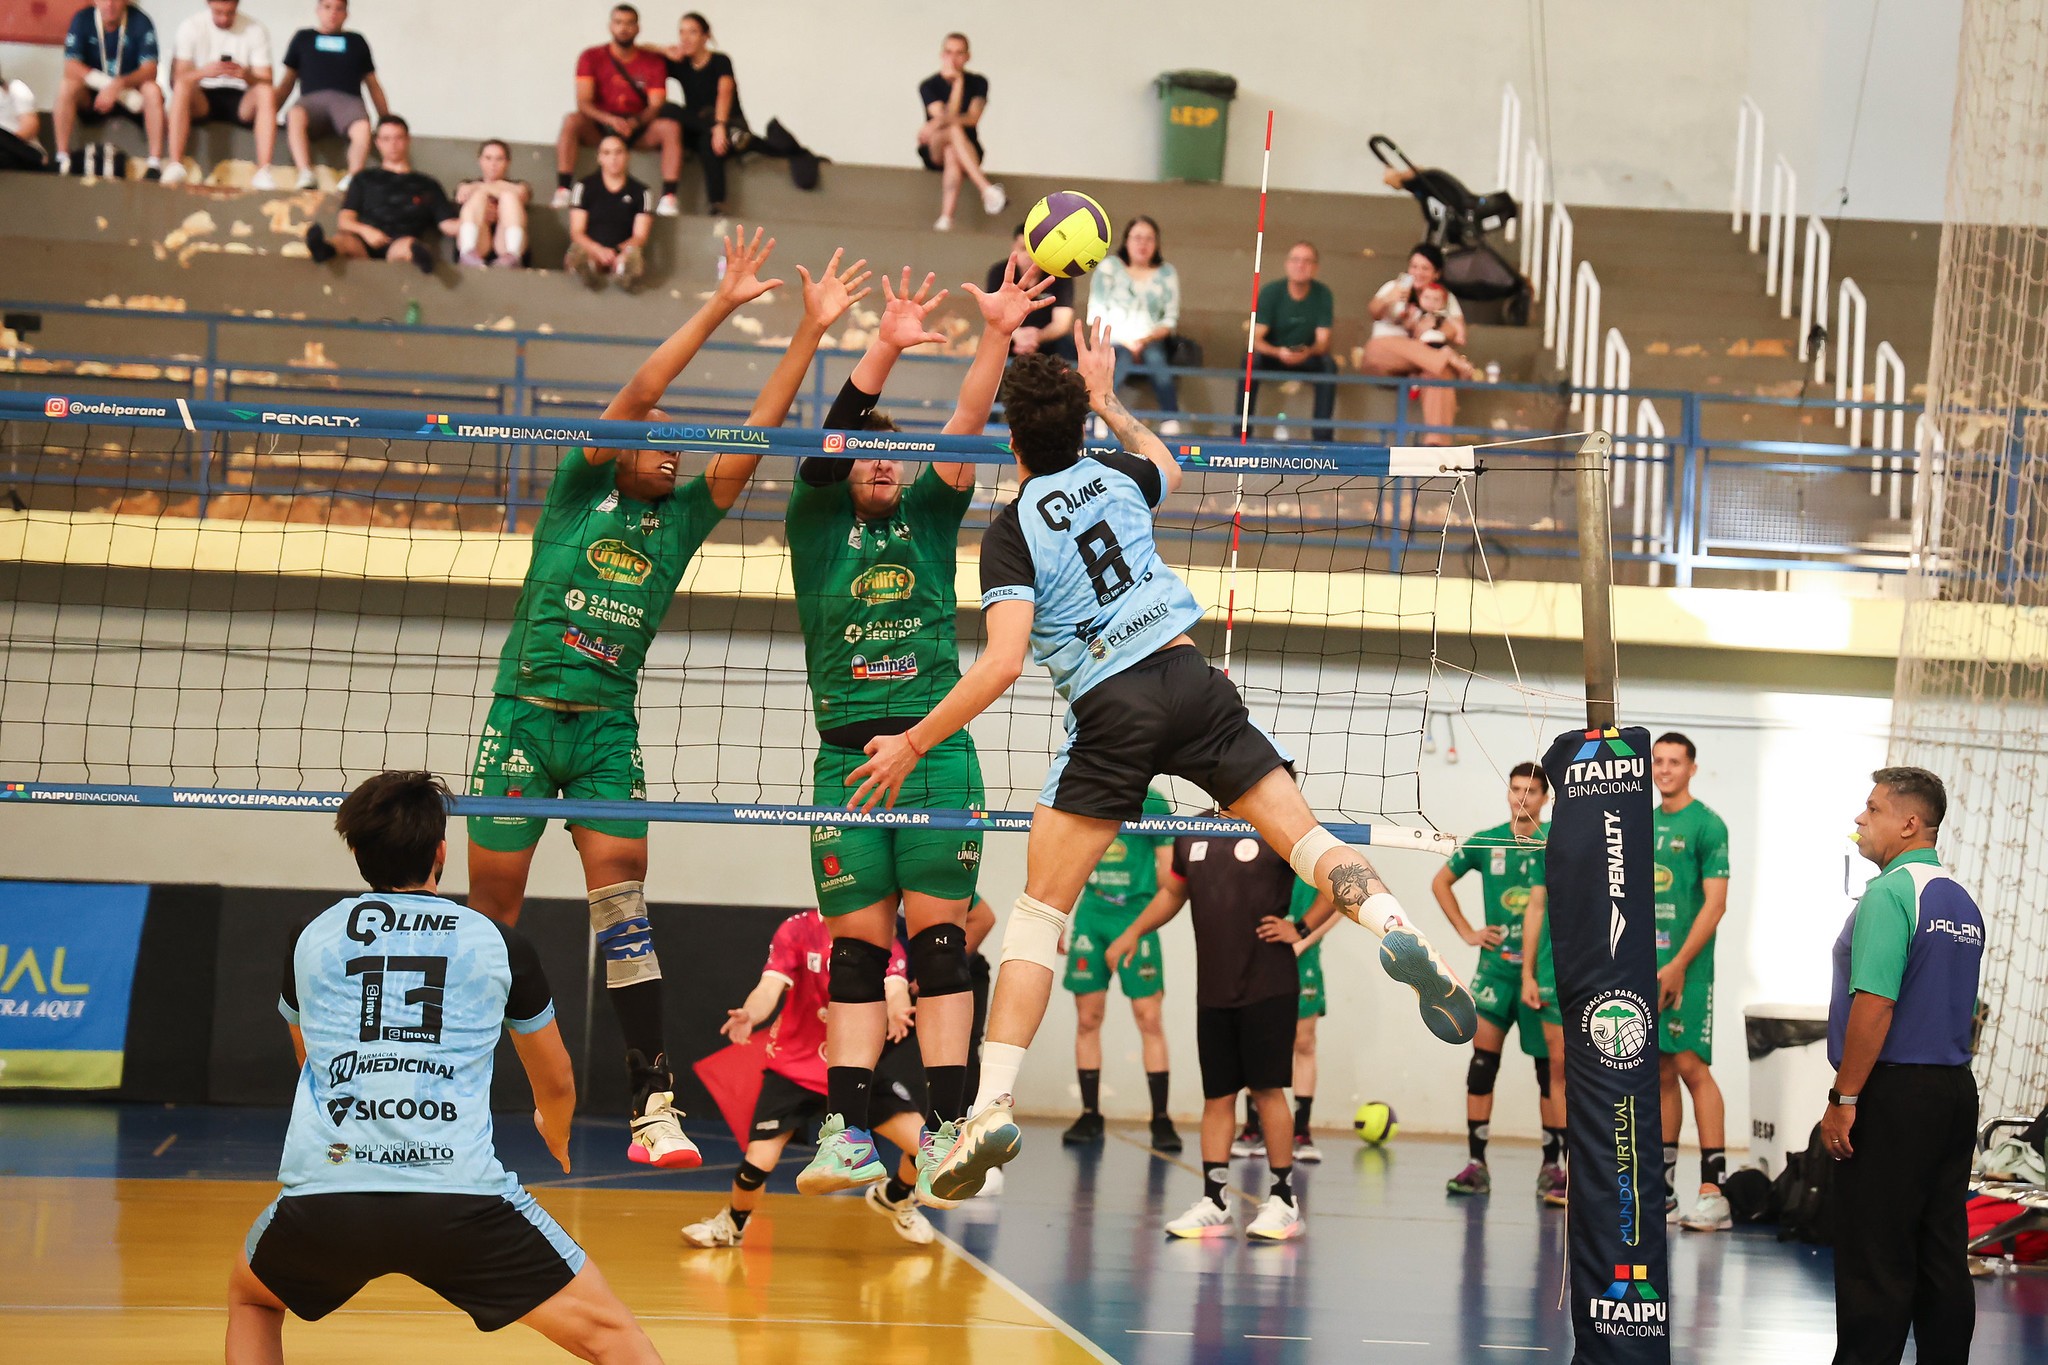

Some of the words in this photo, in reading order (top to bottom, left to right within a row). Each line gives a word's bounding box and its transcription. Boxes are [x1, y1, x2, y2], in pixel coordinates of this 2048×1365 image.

[69, 401, 166, 416] @voleiparana
[262, 411, 359, 428] PENALTY
[458, 425, 511, 438] ITAIPU
[511, 427, 593, 441] BINACIONAL
[650, 427, 705, 439] MUNDO
[705, 428, 770, 442] VIRTUAL
[846, 437, 936, 451] @voleiparana
[1209, 455, 1260, 468] ITAIPU
[1260, 457, 1339, 470] BINACIONAL
[1074, 519, 1137, 608] 8
[590, 594, 644, 618] SANCOR
[587, 607, 641, 628] SEGUROS
[866, 617, 922, 631] SANCOR
[1108, 602, 1168, 646] PLANALTO
[868, 652, 916, 673] uningá
[1564, 757, 1645, 785] ITAIPU
[31, 791, 74, 800] ITAIPU
[74, 793, 140, 803] BINACIONAL
[1568, 780, 1643, 799] BINACIONAL
[733, 808, 930, 825] WWW.VOLEIPARANA.COM.BR
[1604, 810, 1626, 898] PENALTY
[32, 999, 86, 1021] AQUI
[346, 955, 448, 1044] 13
[1582, 990, 1612, 1033] FEDERAÇÃO
[1614, 989, 1653, 1030] PARANAENSE
[356, 1058, 455, 1080] MEDICINAL
[1600, 1056, 1645, 1070] VOLEIBOL
[355, 1098, 458, 1121] SICOOB
[1613, 1096, 1631, 1174] VIRTUAL
[355, 1147, 454, 1163] PLANALTO
[1617, 1174, 1634, 1242] MUNDO
[1590, 1298, 1667, 1323] ITAIPU
[1595, 1321, 1666, 1337] BINACIONAL
